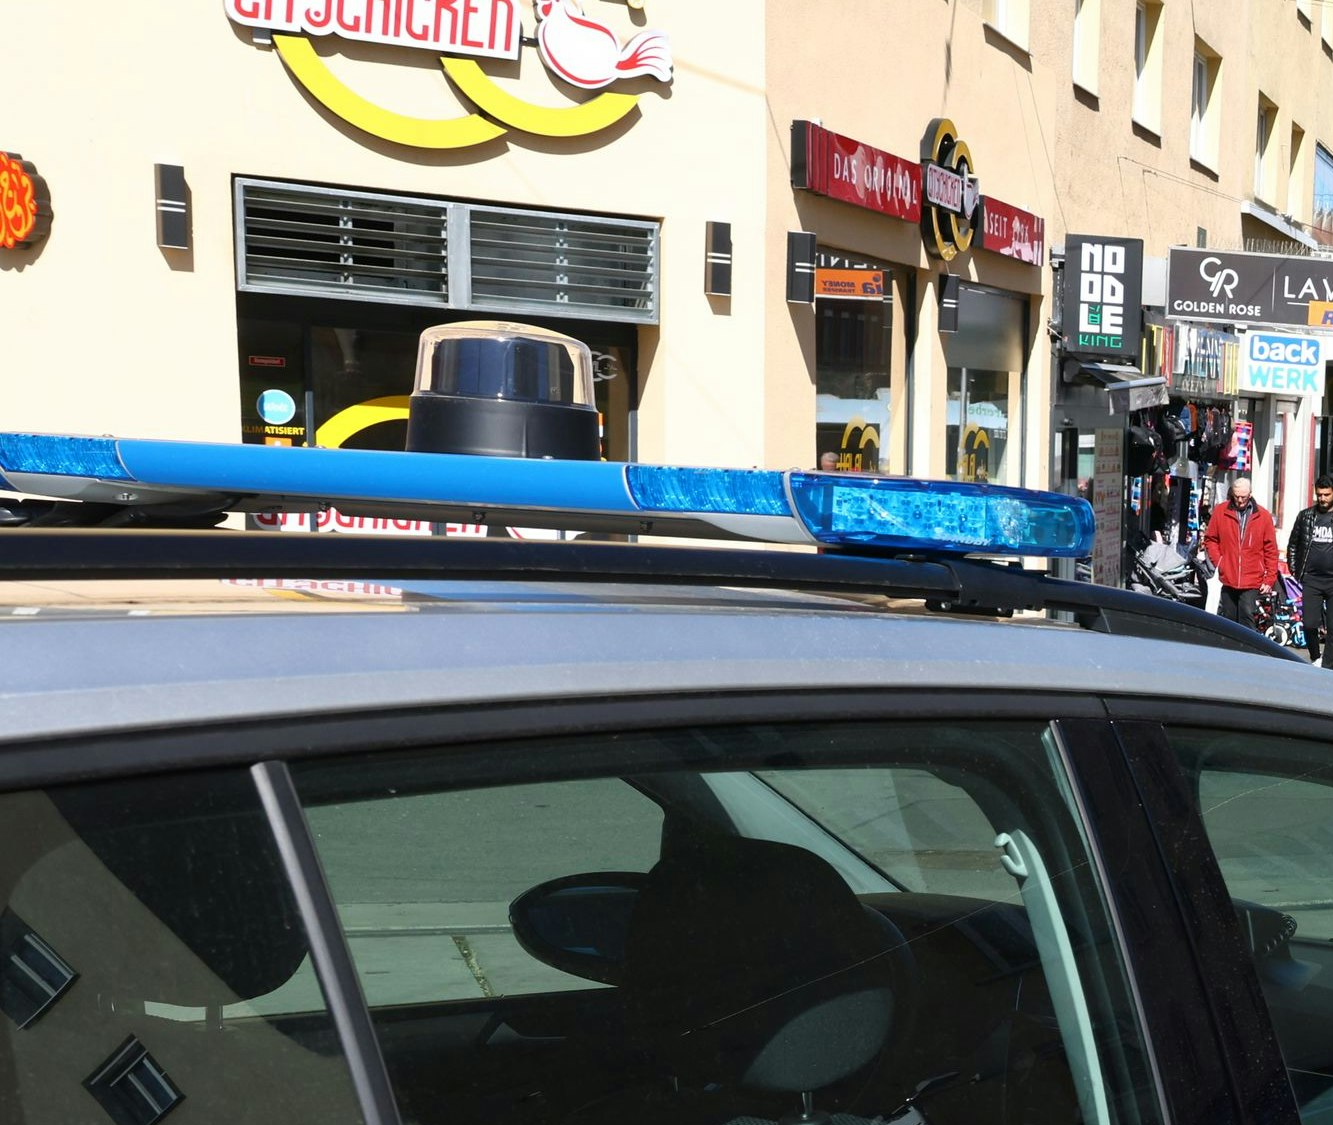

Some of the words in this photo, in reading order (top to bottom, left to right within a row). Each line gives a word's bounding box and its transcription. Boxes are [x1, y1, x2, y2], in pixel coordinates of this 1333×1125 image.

[834, 153, 857, 184] DAS
[989, 212, 1008, 238] SEIT
[1174, 300, 1225, 315] GOLDEN
[1229, 305, 1262, 317] ROSE
[1079, 334, 1122, 348] KING
[1253, 335, 1319, 364] back
[1248, 364, 1320, 392] WERK
